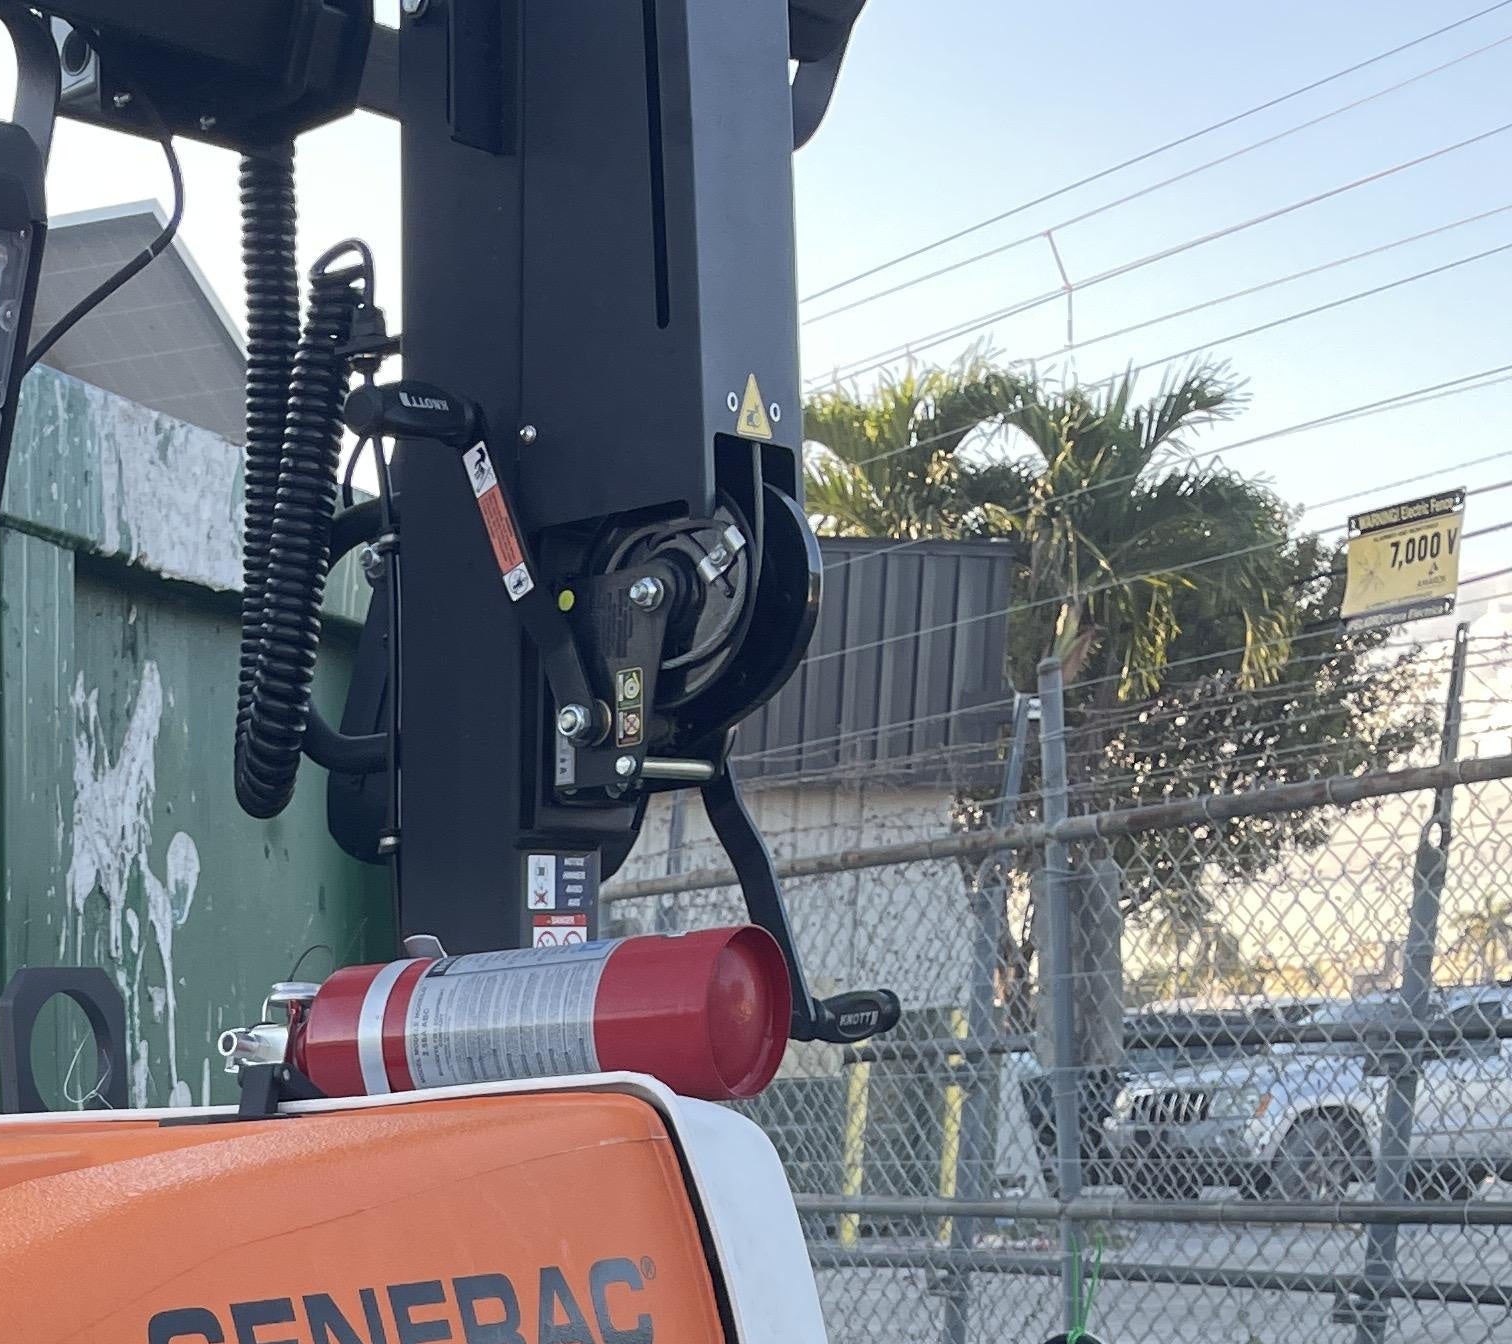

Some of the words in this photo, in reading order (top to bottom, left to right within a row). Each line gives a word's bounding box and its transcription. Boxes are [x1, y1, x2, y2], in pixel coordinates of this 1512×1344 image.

[1390, 531, 1441, 571] 7,000
[1448, 527, 1459, 555] V
[840, 1011, 872, 1026] KNOTT
